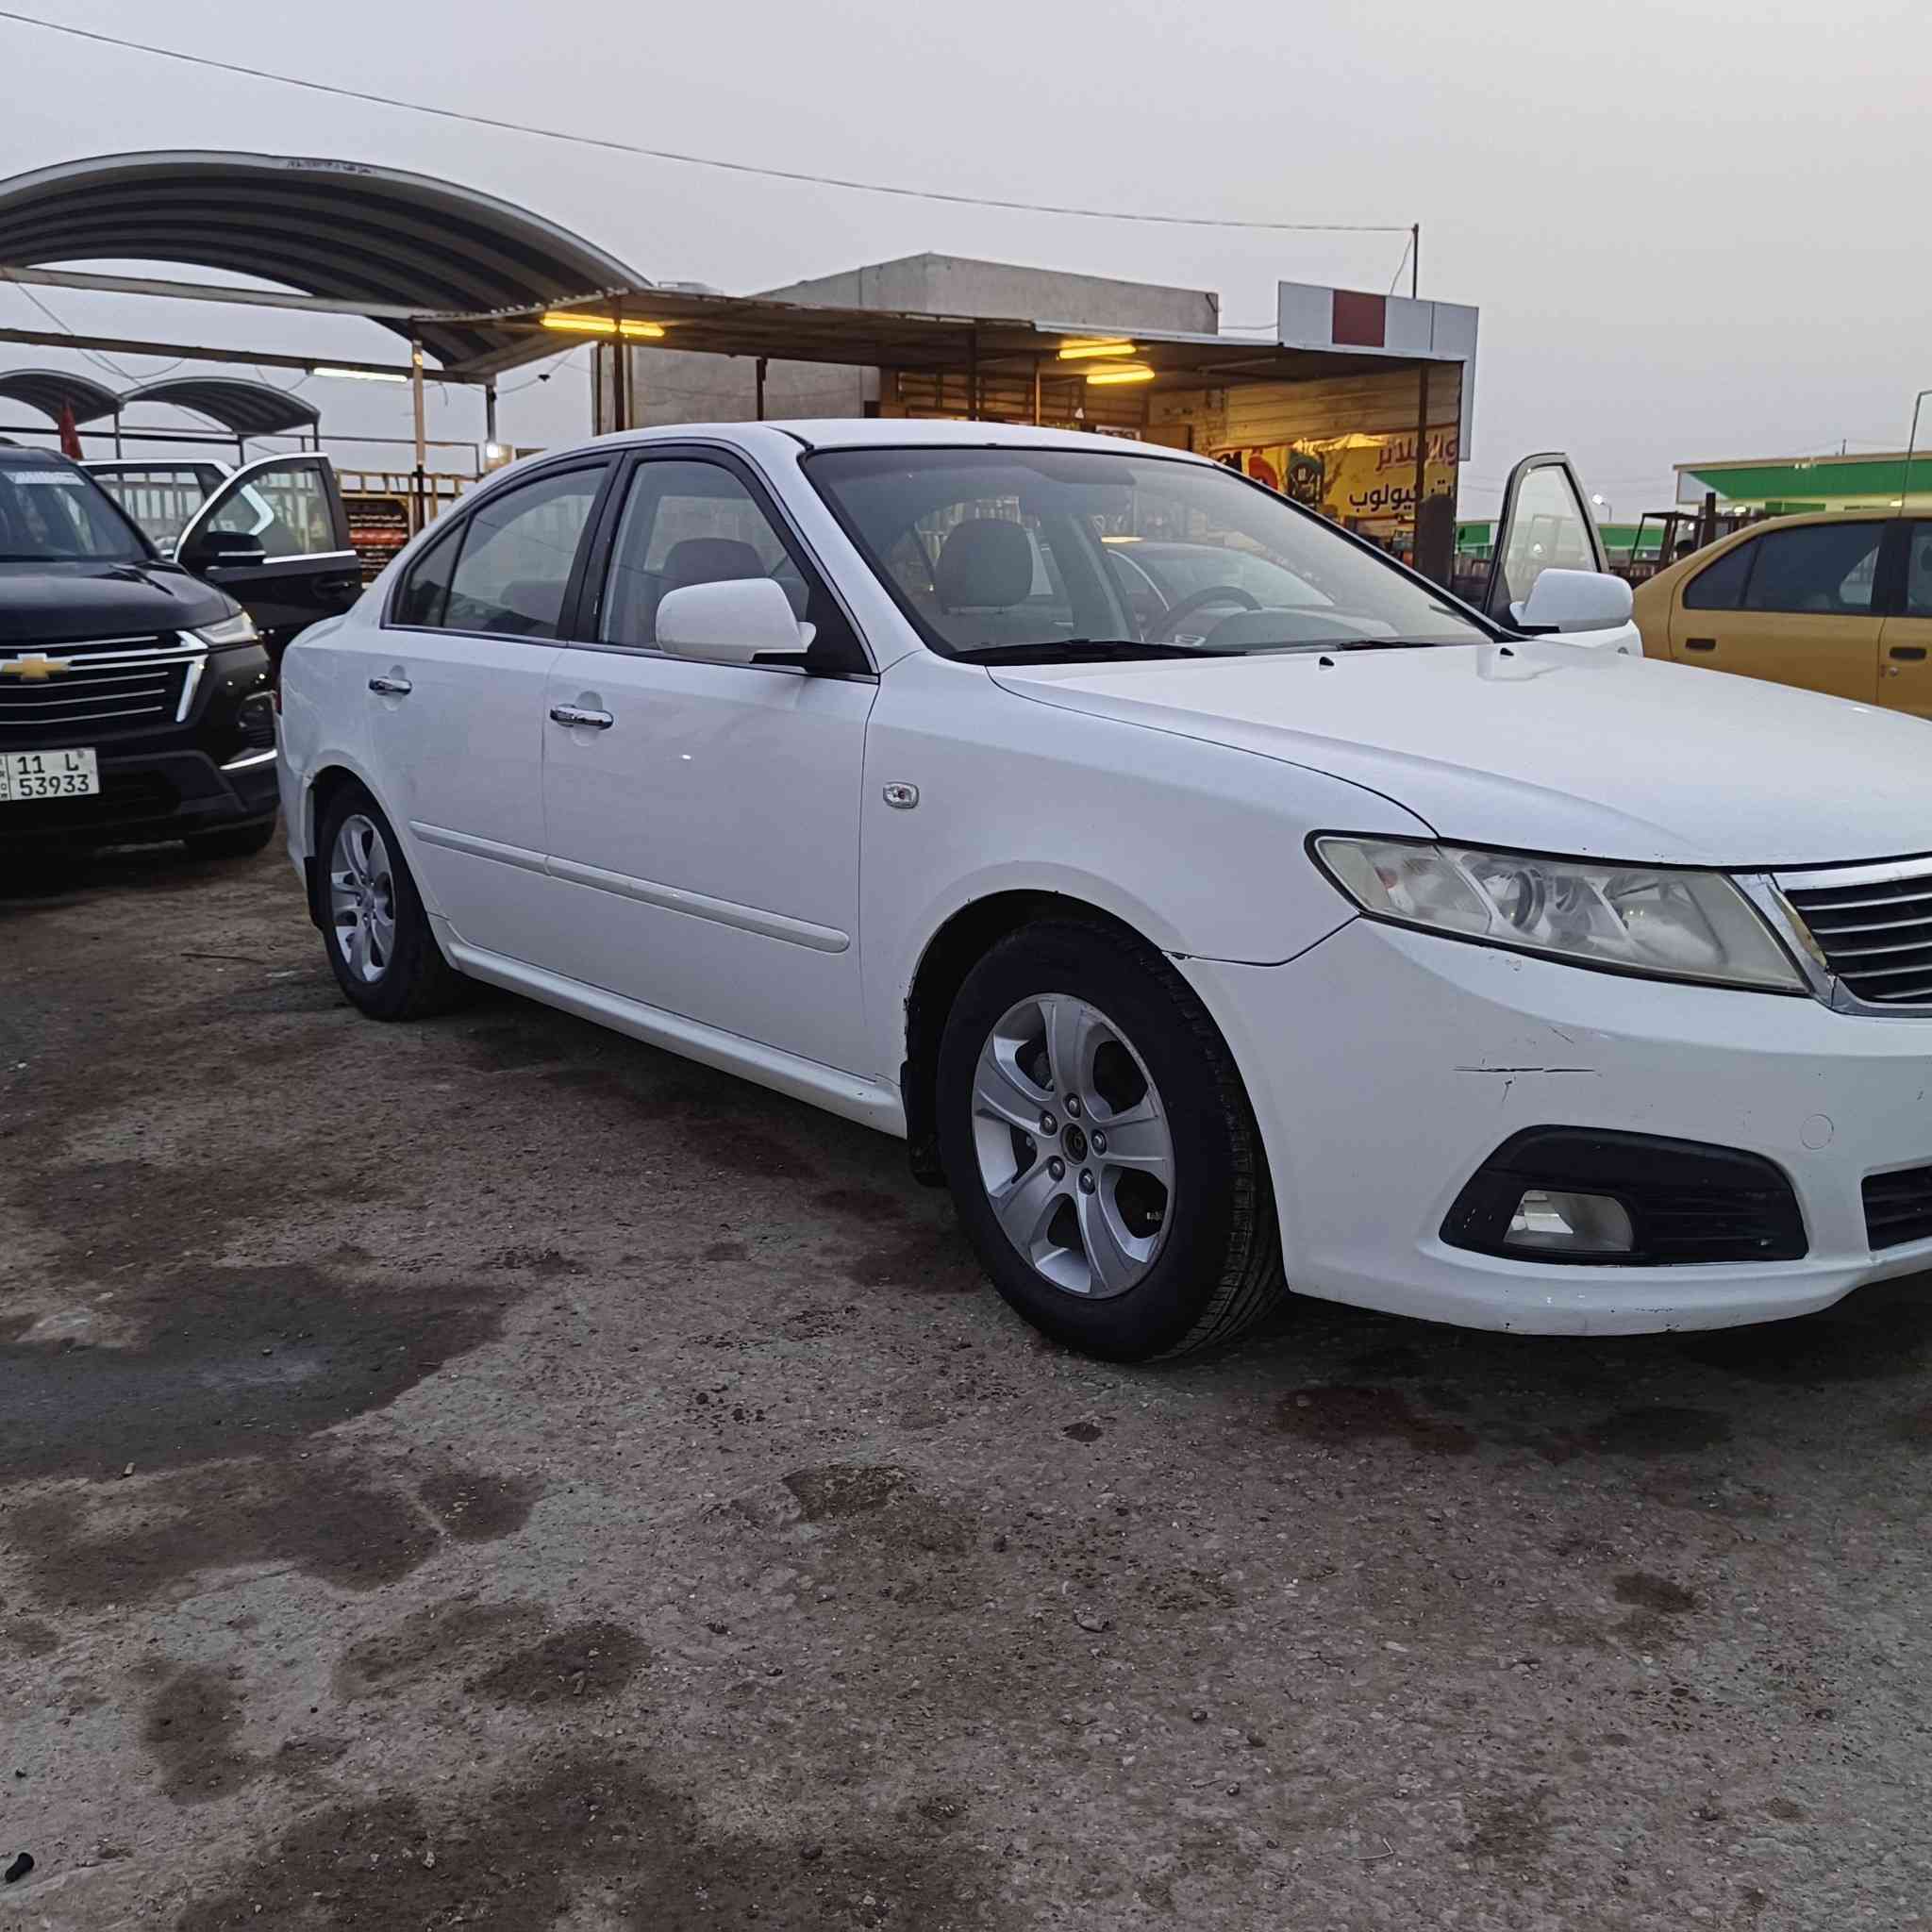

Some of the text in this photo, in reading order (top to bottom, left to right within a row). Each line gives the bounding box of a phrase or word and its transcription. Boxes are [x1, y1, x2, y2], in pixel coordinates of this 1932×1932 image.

[1348, 482, 1418, 512] يولوب
[17, 755, 45, 774] 11
[19, 774, 90, 796] 53933
